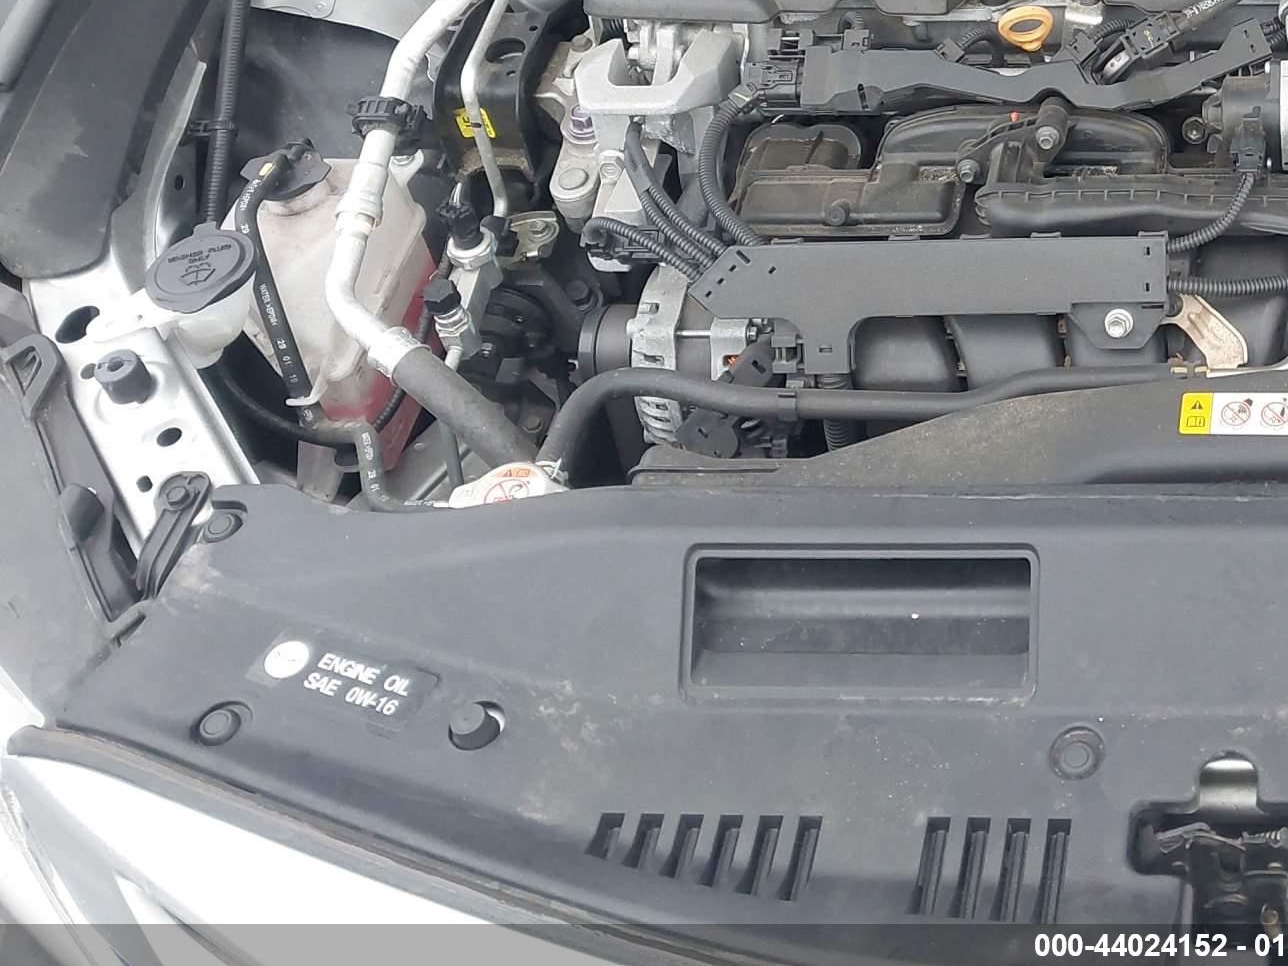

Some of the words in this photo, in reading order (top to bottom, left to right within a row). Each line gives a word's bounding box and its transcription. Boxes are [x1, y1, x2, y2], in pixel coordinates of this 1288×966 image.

[304, 672, 342, 697] SAE
[344, 686, 400, 716] 0W-16
[317, 652, 381, 685] ENGINE
[383, 674, 409, 697] OIL
